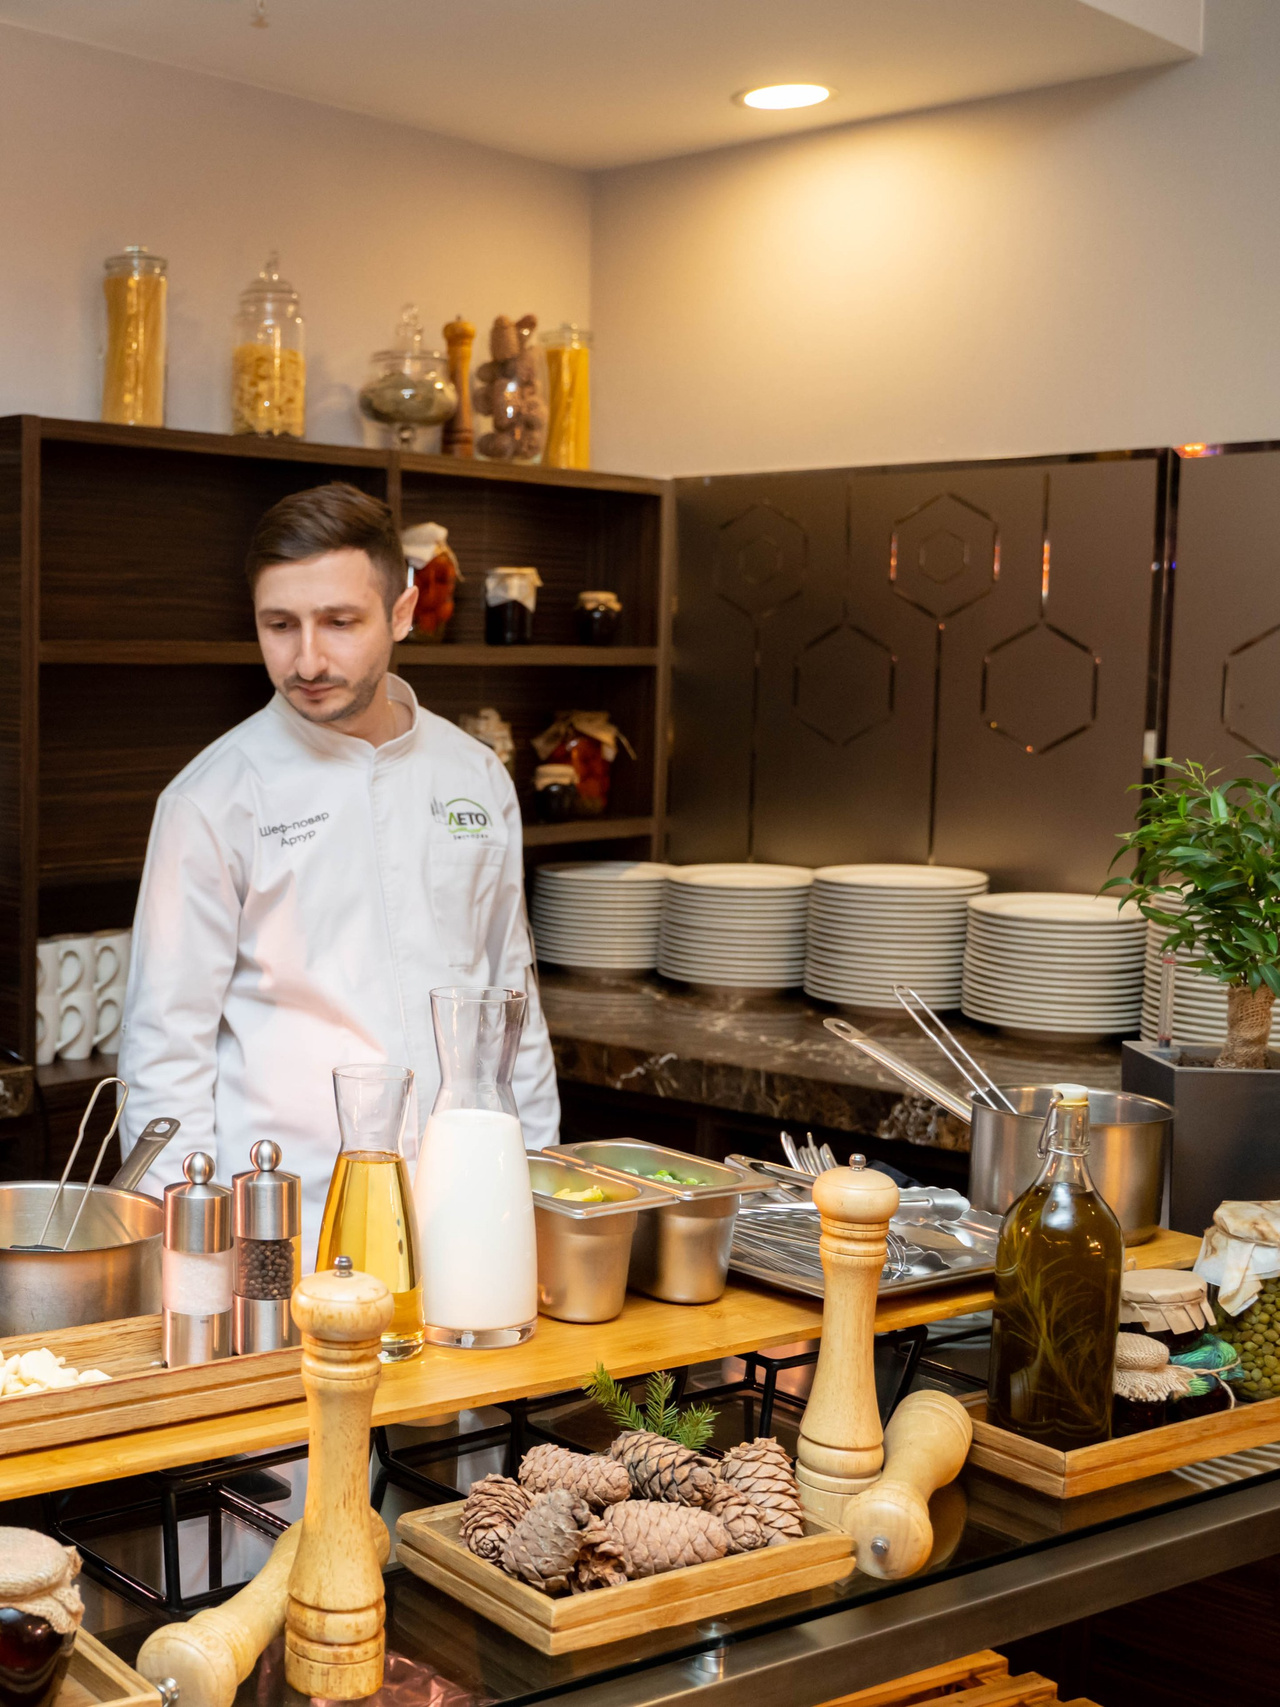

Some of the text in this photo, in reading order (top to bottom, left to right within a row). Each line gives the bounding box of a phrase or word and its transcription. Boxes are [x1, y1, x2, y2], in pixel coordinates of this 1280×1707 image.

[259, 811, 330, 837] Шеф-повар
[448, 811, 488, 827] ЛЕТО
[280, 830, 317, 848] Артур
